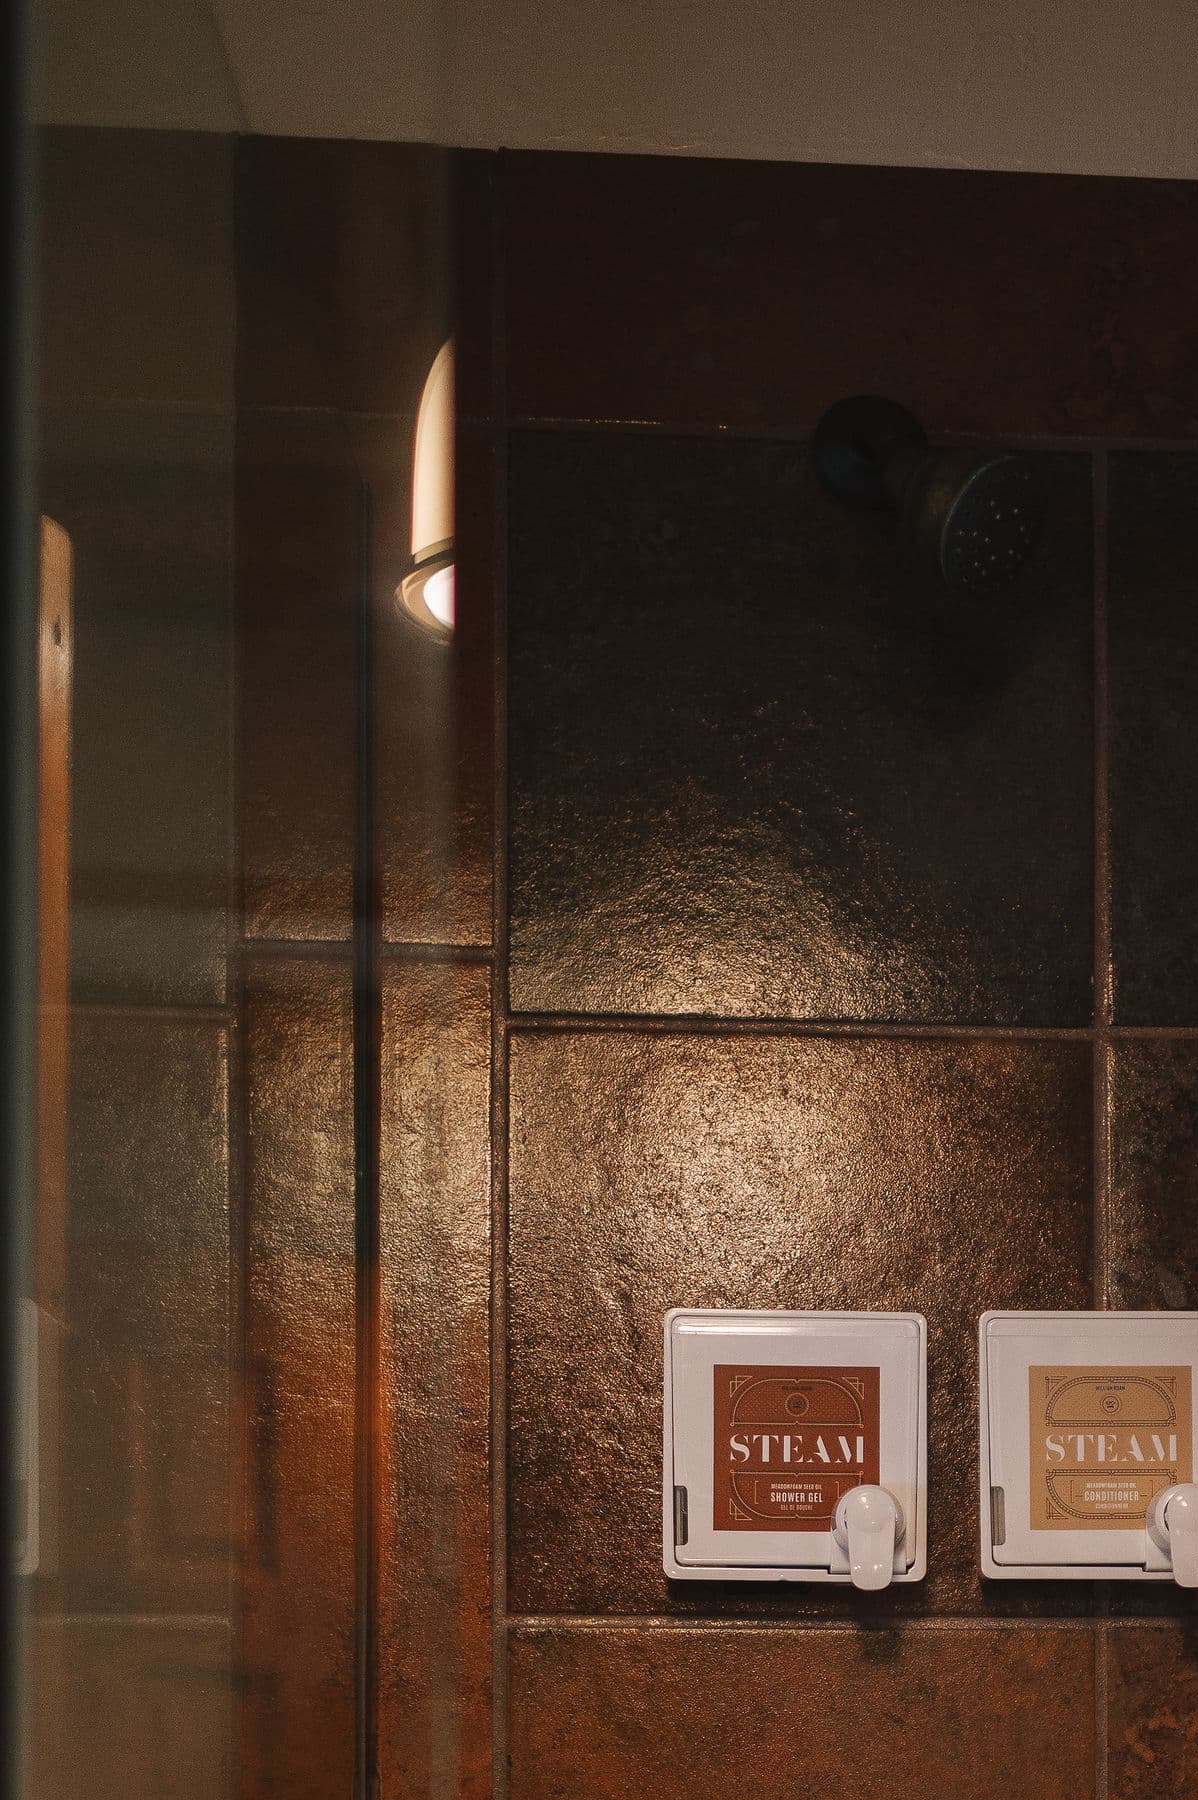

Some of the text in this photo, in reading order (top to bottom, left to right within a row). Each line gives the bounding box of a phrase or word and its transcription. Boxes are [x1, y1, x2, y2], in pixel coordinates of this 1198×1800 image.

[729, 1433, 864, 1464] STEAM
[1045, 1433, 1178, 1463] STEAM
[770, 1491, 823, 1503] SHOWER GEL
[1084, 1490, 1139, 1502] CONDITIONER
